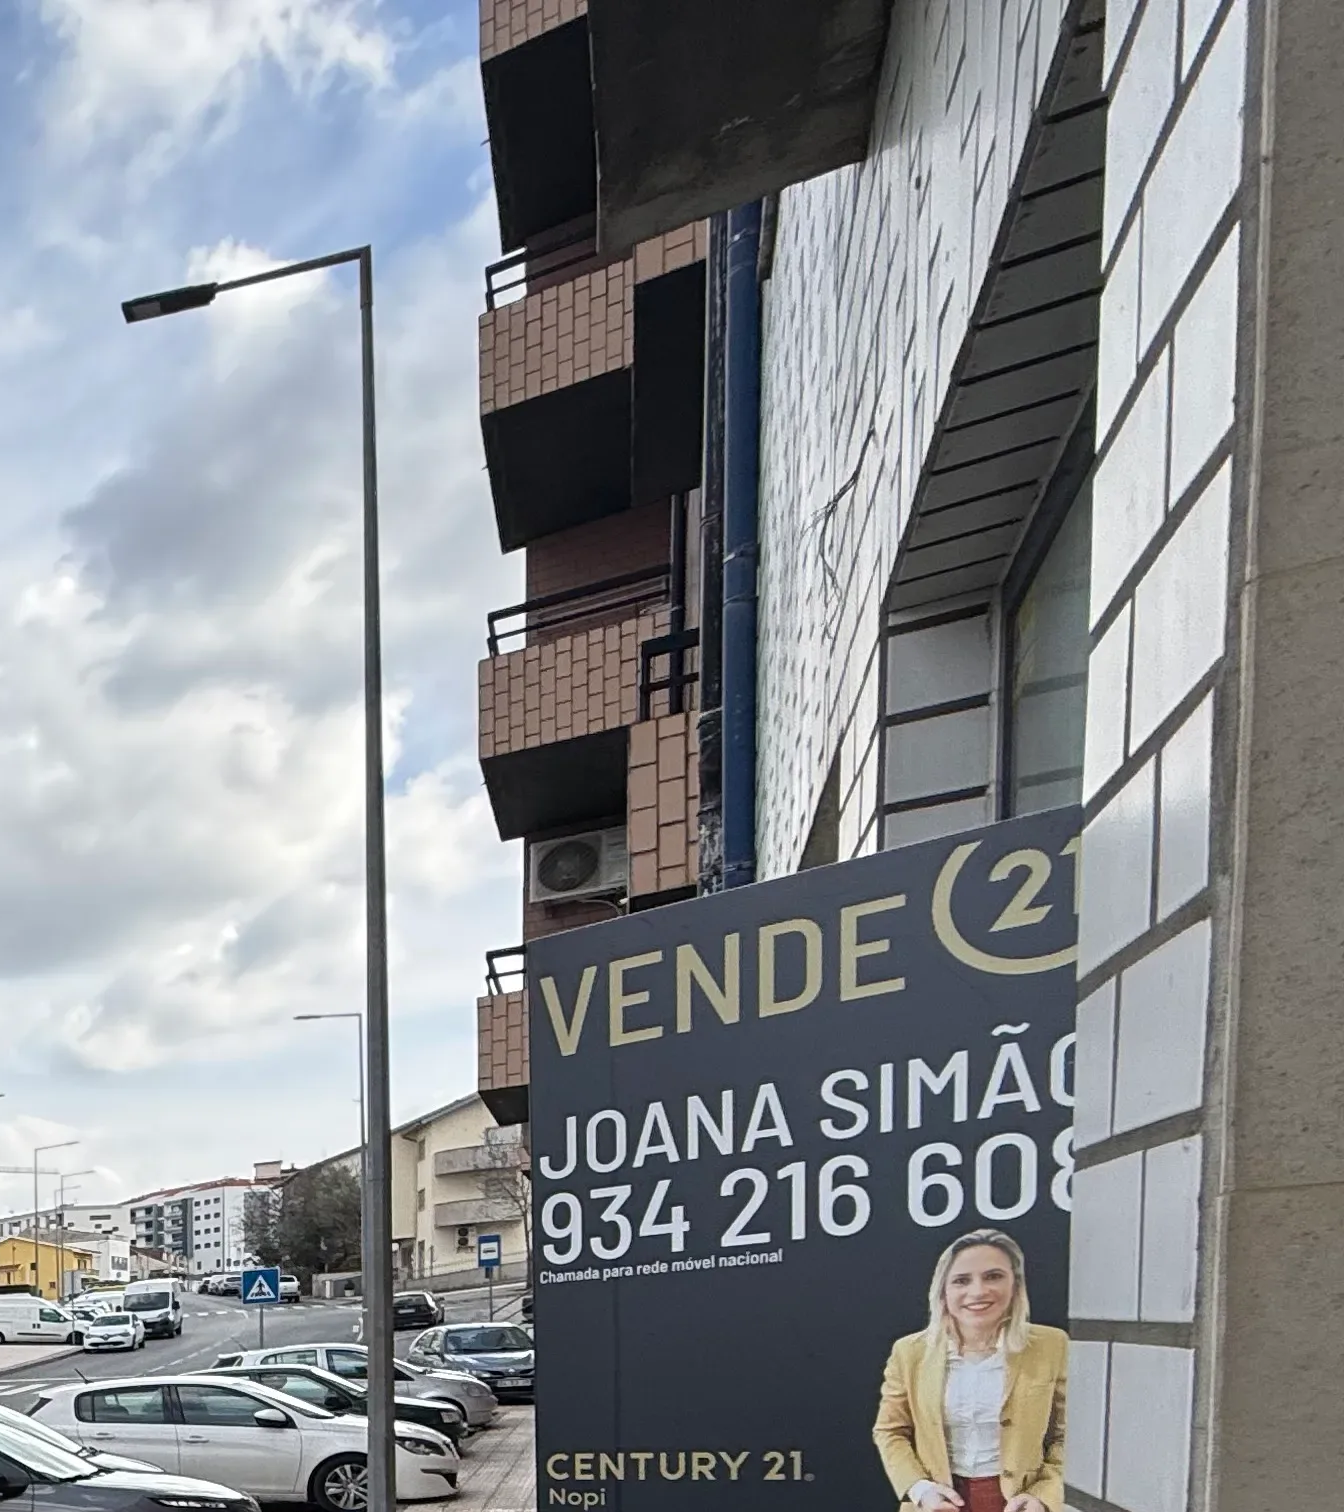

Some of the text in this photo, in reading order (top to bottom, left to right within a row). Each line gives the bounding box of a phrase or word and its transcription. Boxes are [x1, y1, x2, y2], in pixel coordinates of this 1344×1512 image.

[539, 893, 907, 1057] VENDE
[539, 1082, 793, 1180] JOANA
[542, 1179, 690, 1266] 934
[720, 1155, 871, 1248] 216
[539, 1248, 783, 1285] Chamada para rede móvel nacional
[546, 1451, 751, 1481] CENTURY
[548, 1487, 606, 1511] Nopi
